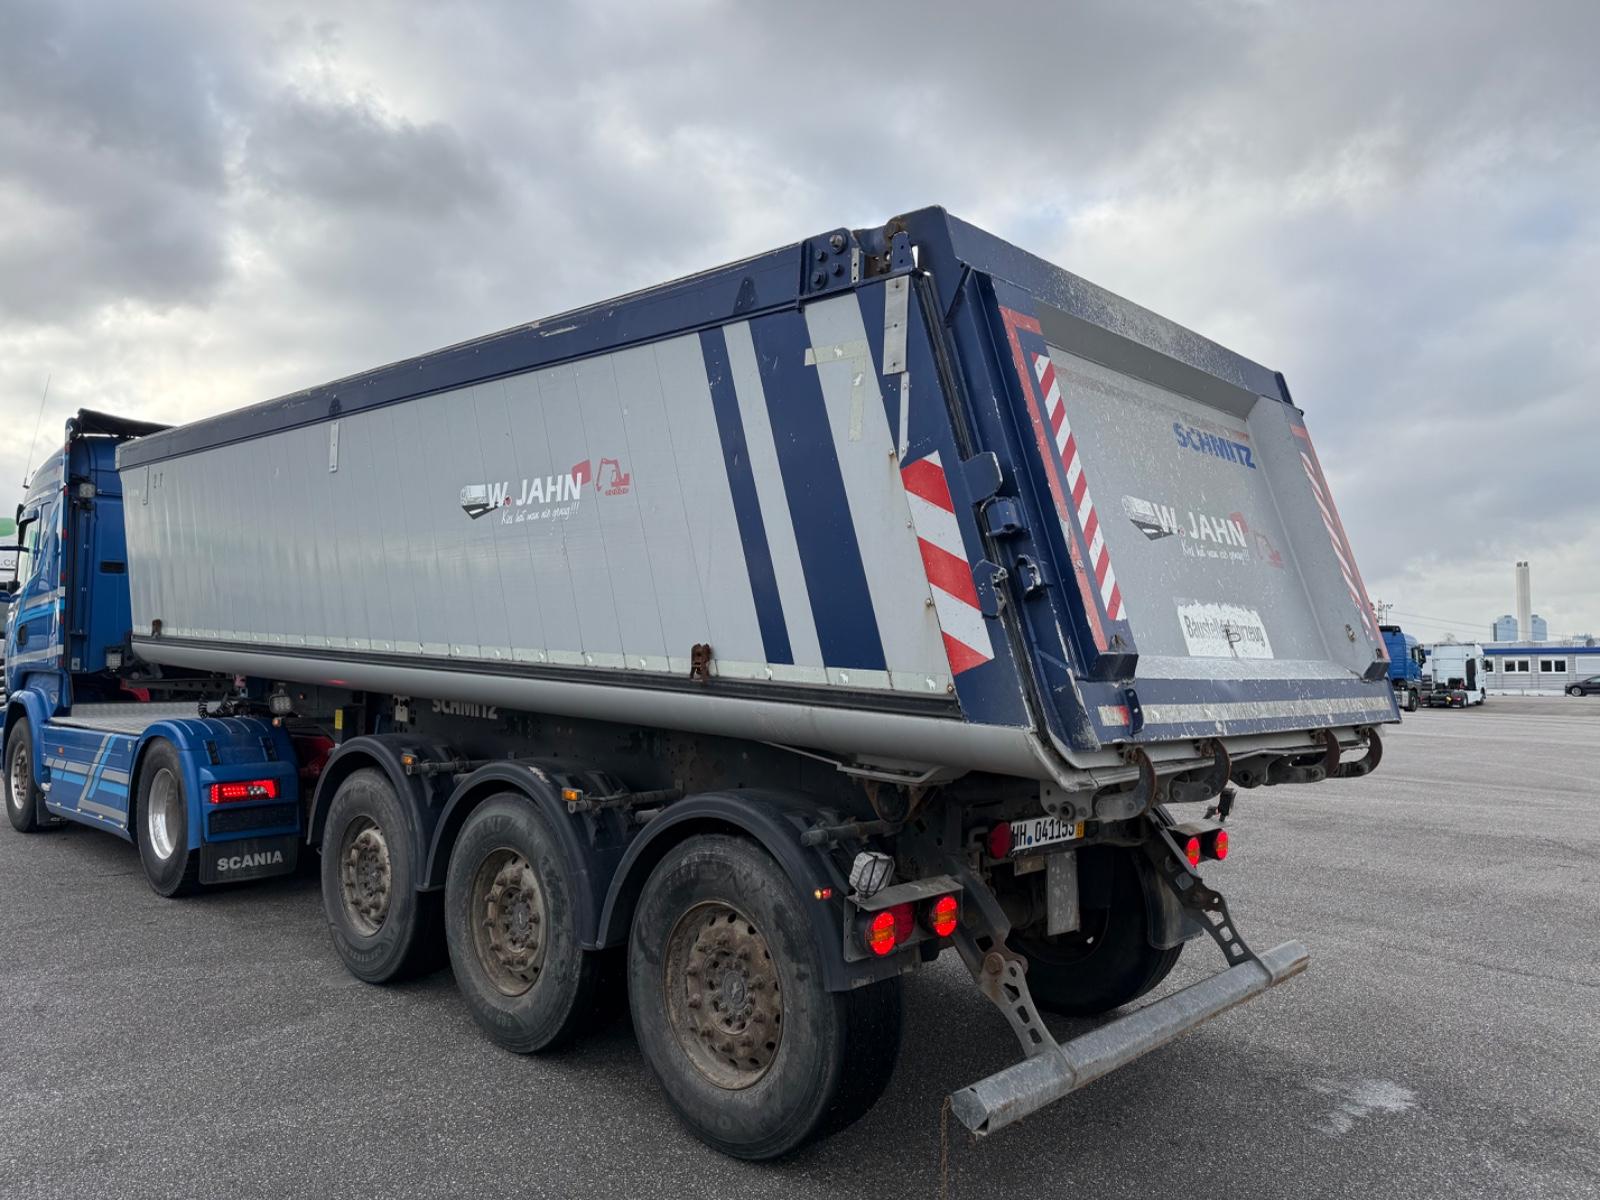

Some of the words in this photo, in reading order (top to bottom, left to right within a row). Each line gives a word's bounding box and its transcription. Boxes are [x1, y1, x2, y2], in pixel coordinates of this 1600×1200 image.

[1172, 422, 1257, 470] SCHMITZ
[516, 472, 582, 506] JAHN
[1187, 511, 1248, 548] JAHN
[217, 850, 283, 871] SCANIA
